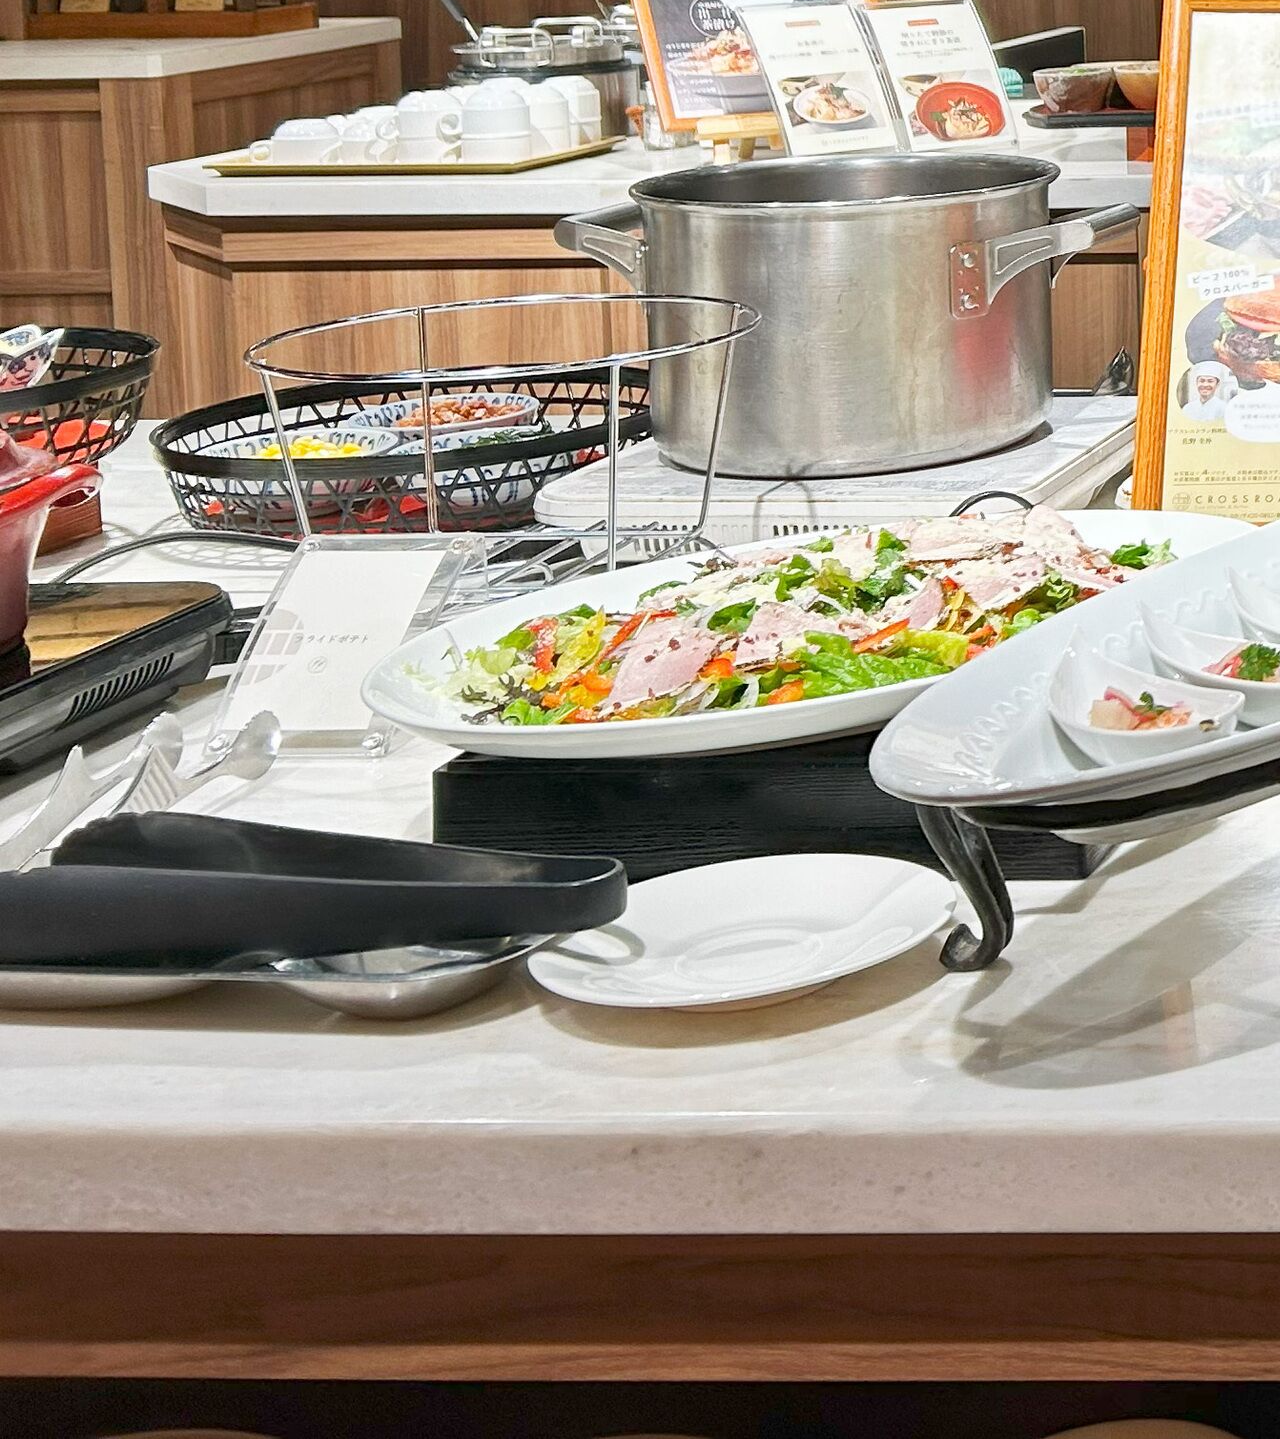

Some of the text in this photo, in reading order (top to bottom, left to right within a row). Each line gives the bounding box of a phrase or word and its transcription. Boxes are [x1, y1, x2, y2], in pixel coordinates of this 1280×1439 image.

[1203, 281, 1269, 297] クロスバーガー
[294, 633, 369, 644] フライドポテト
